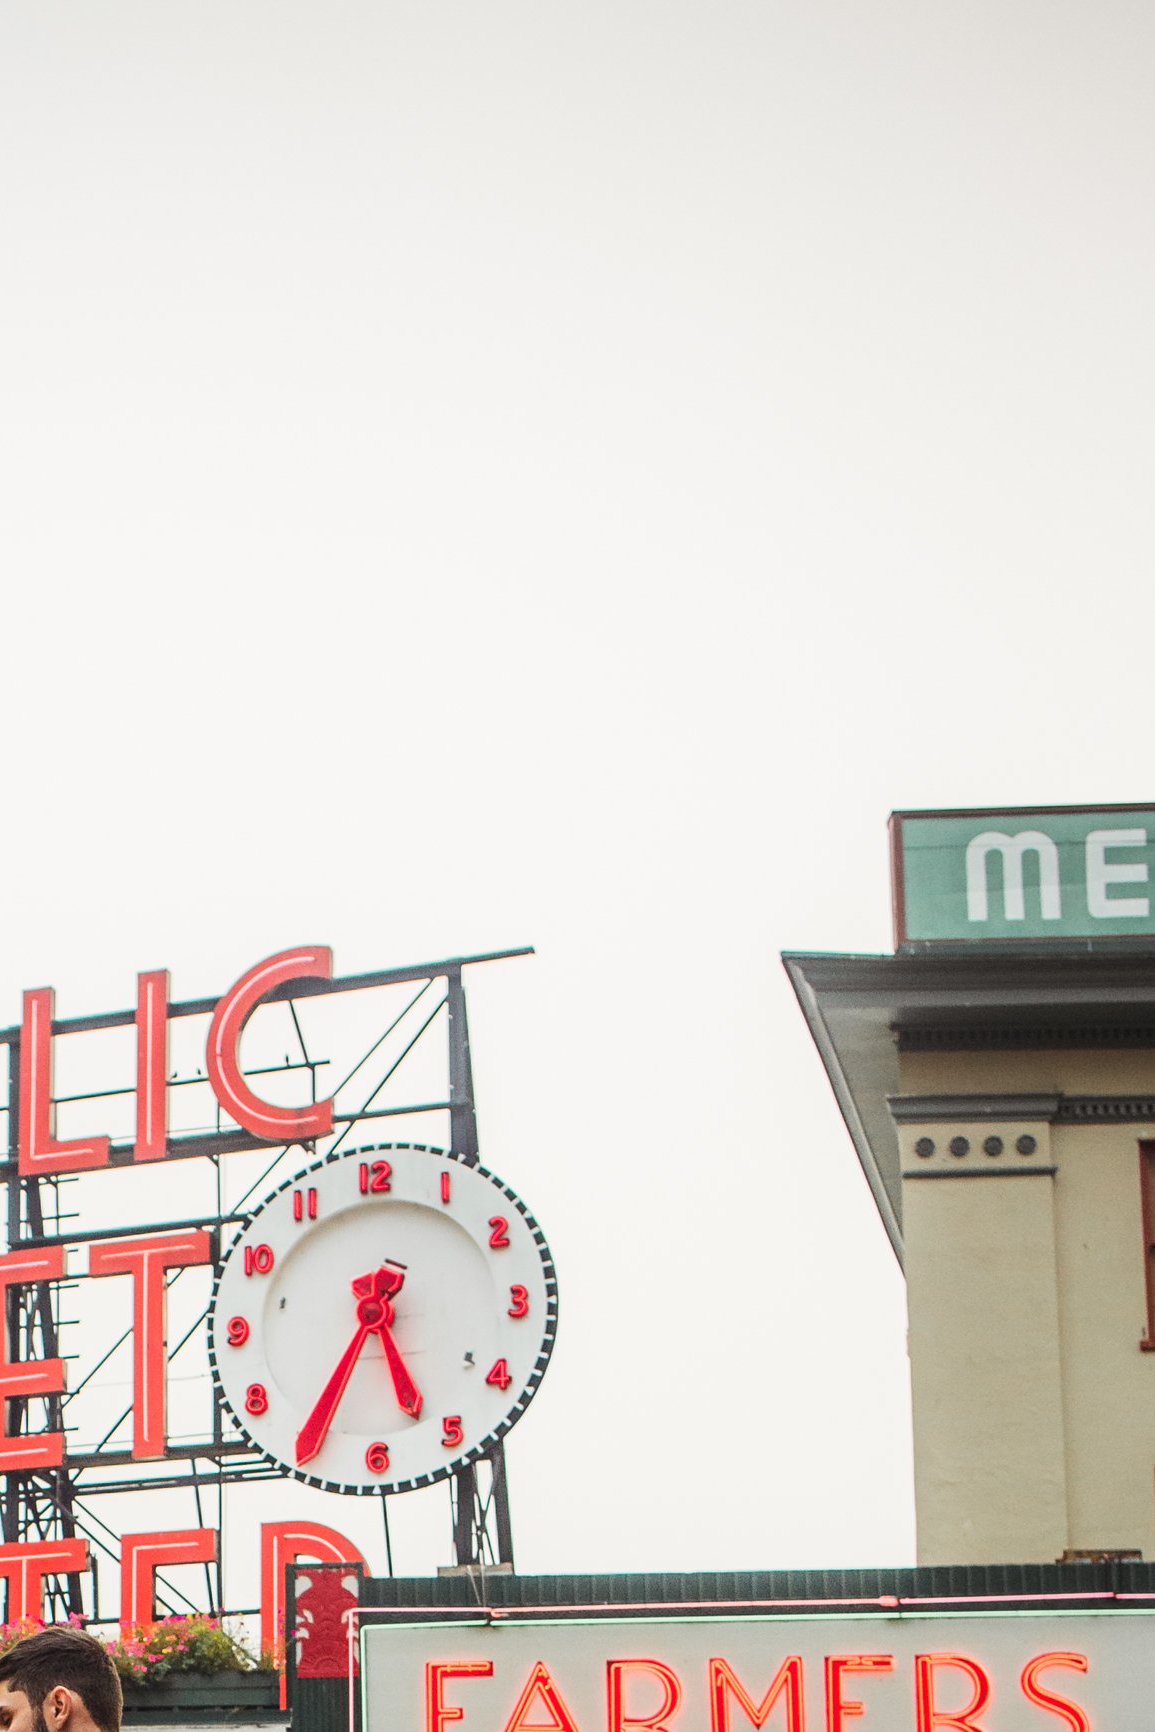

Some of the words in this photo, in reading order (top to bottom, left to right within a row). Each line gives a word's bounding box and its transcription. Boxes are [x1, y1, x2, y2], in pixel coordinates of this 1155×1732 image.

[359, 1160, 392, 1194] 12
[441, 1172, 450, 1205] 1
[293, 1187, 317, 1221] 11
[488, 1215, 510, 1248] 2
[244, 1244, 274, 1276] 10
[507, 1284, 529, 1318] 3
[227, 1316, 250, 1346] 9
[486, 1358, 512, 1390] 4
[245, 1383, 268, 1415] 8
[441, 1415, 463, 1447] 5
[365, 1442, 389, 1474] 6
